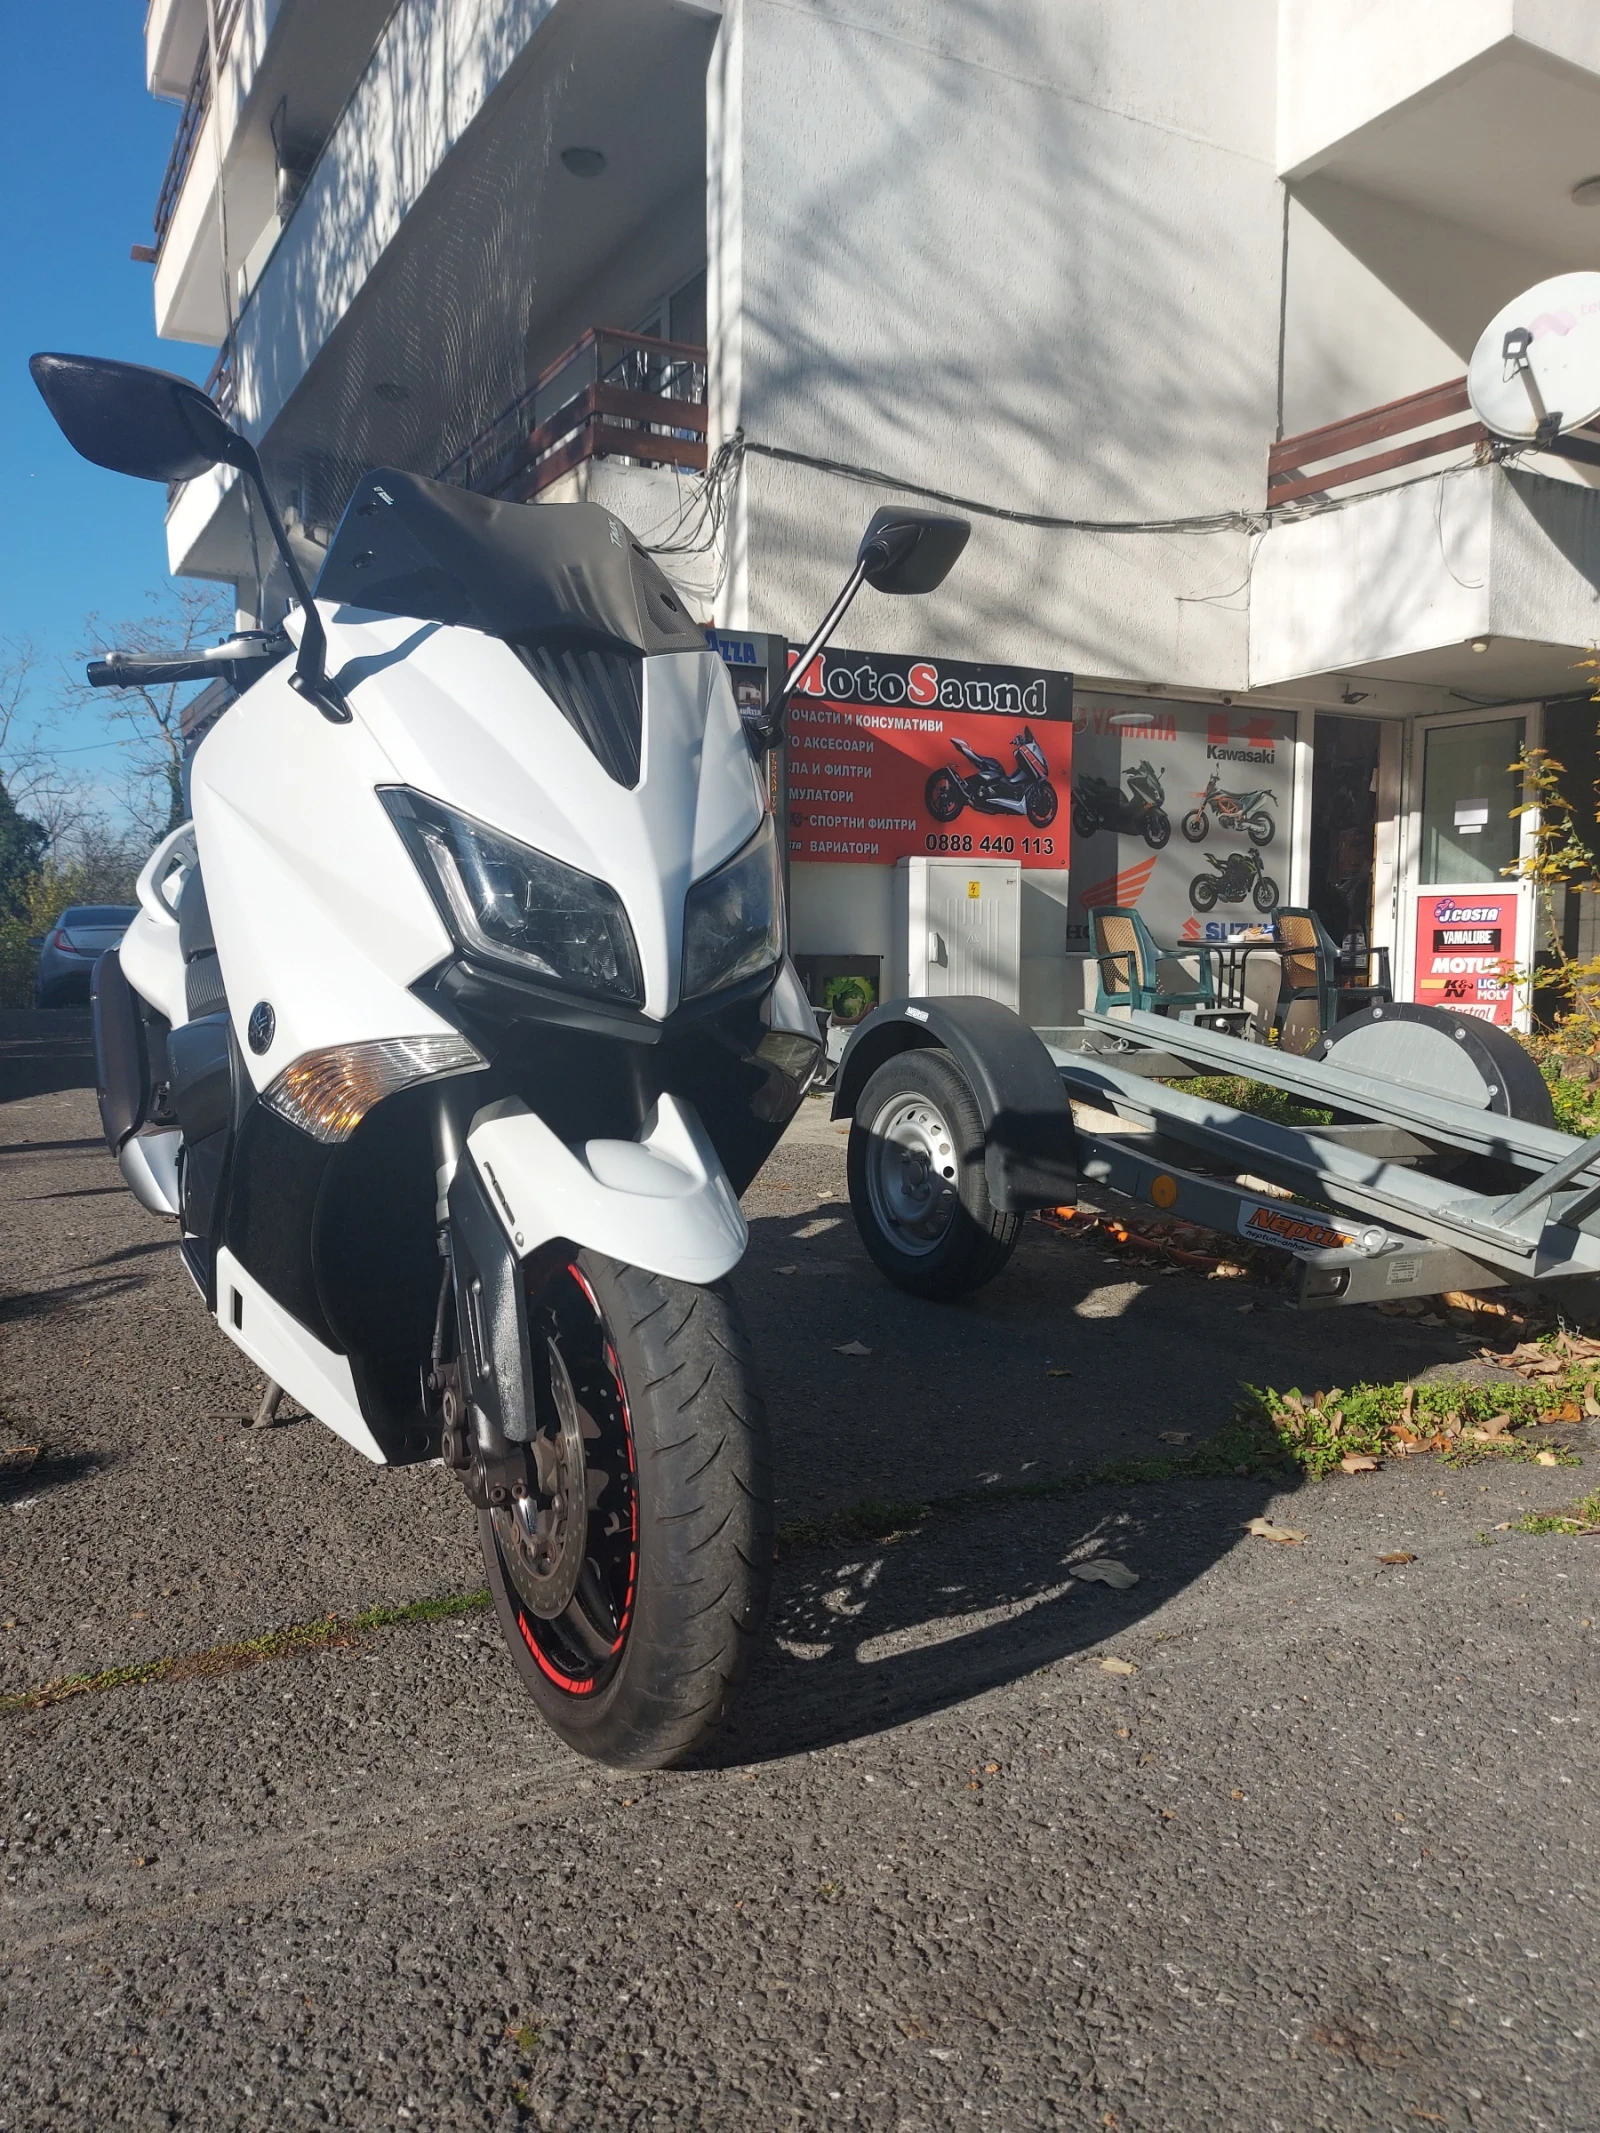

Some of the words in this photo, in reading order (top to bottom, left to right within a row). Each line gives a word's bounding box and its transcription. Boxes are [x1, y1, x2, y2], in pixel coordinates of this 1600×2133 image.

[789, 708, 841, 725] ОЧАСТИ
[844, 713, 853, 726] И
[855, 714, 944, 733] КОНСУМАТИВИ
[789, 735, 801, 748] О
[804, 736, 875, 753] АКСЕСОАРИ
[1206, 744, 1275, 765] Kawasaki
[789, 762, 809, 774] ЛА
[812, 763, 821, 775] И
[824, 764, 873, 779] ФИЛТРИ
[788, 787, 855, 803] МУЛАТОРИ
[809, 815, 865, 829] СПОРТНИ
[867, 818, 918, 832] ФИЛТРИ
[810, 841, 880, 855] ВАРИАТОРИ
[925, 833, 974, 852] 0888
[979, 835, 1015, 854] 440
[1021, 836, 1056, 855] 113
[1438, 907, 1499, 923] J.COSTA
[1205, 922, 1268, 940] SUZ
[1442, 930, 1494, 945] YAMALUBE
[1430, 957, 1502, 974] MOTUL
[1477, 979, 1509, 989] LIQ
[1477, 990, 1509, 1000] MOLY
